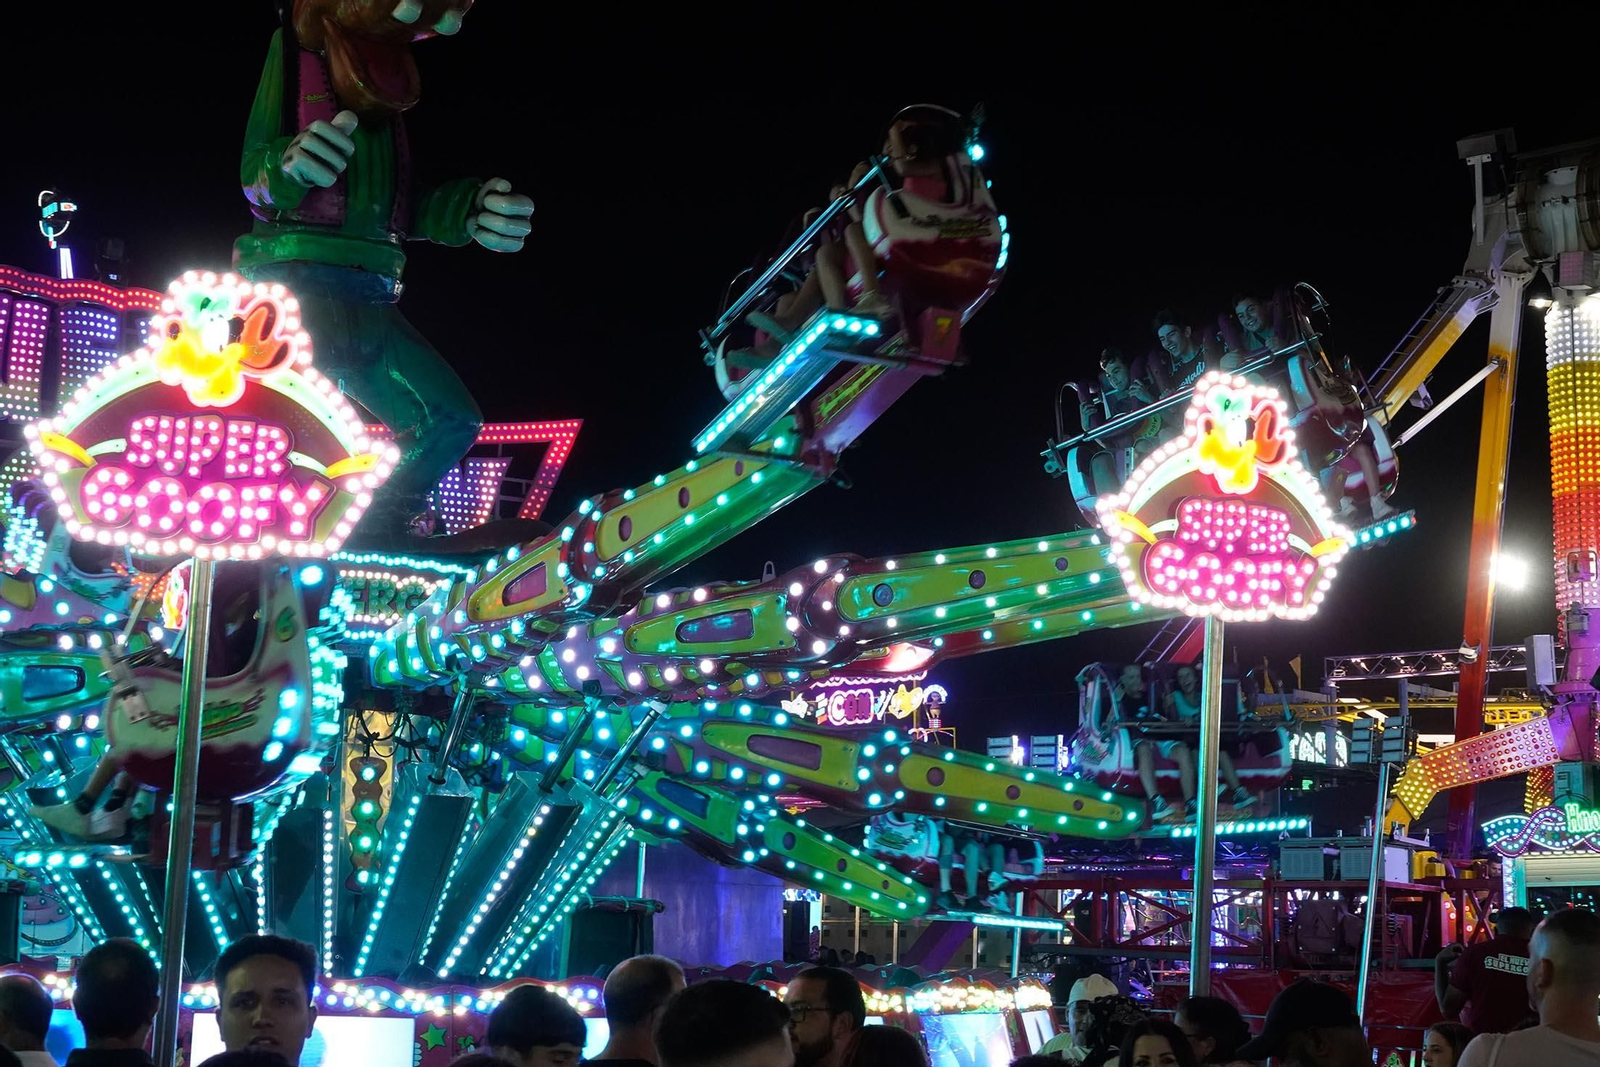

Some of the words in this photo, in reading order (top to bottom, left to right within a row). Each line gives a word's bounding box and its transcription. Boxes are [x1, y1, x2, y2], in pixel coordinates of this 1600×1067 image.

[126, 412, 292, 479] SUPER
[80, 466, 334, 543] GOOFY
[1177, 498, 1290, 554] SUPER
[1147, 542, 1318, 606] GOOFY
[275, 606, 297, 642] 6
